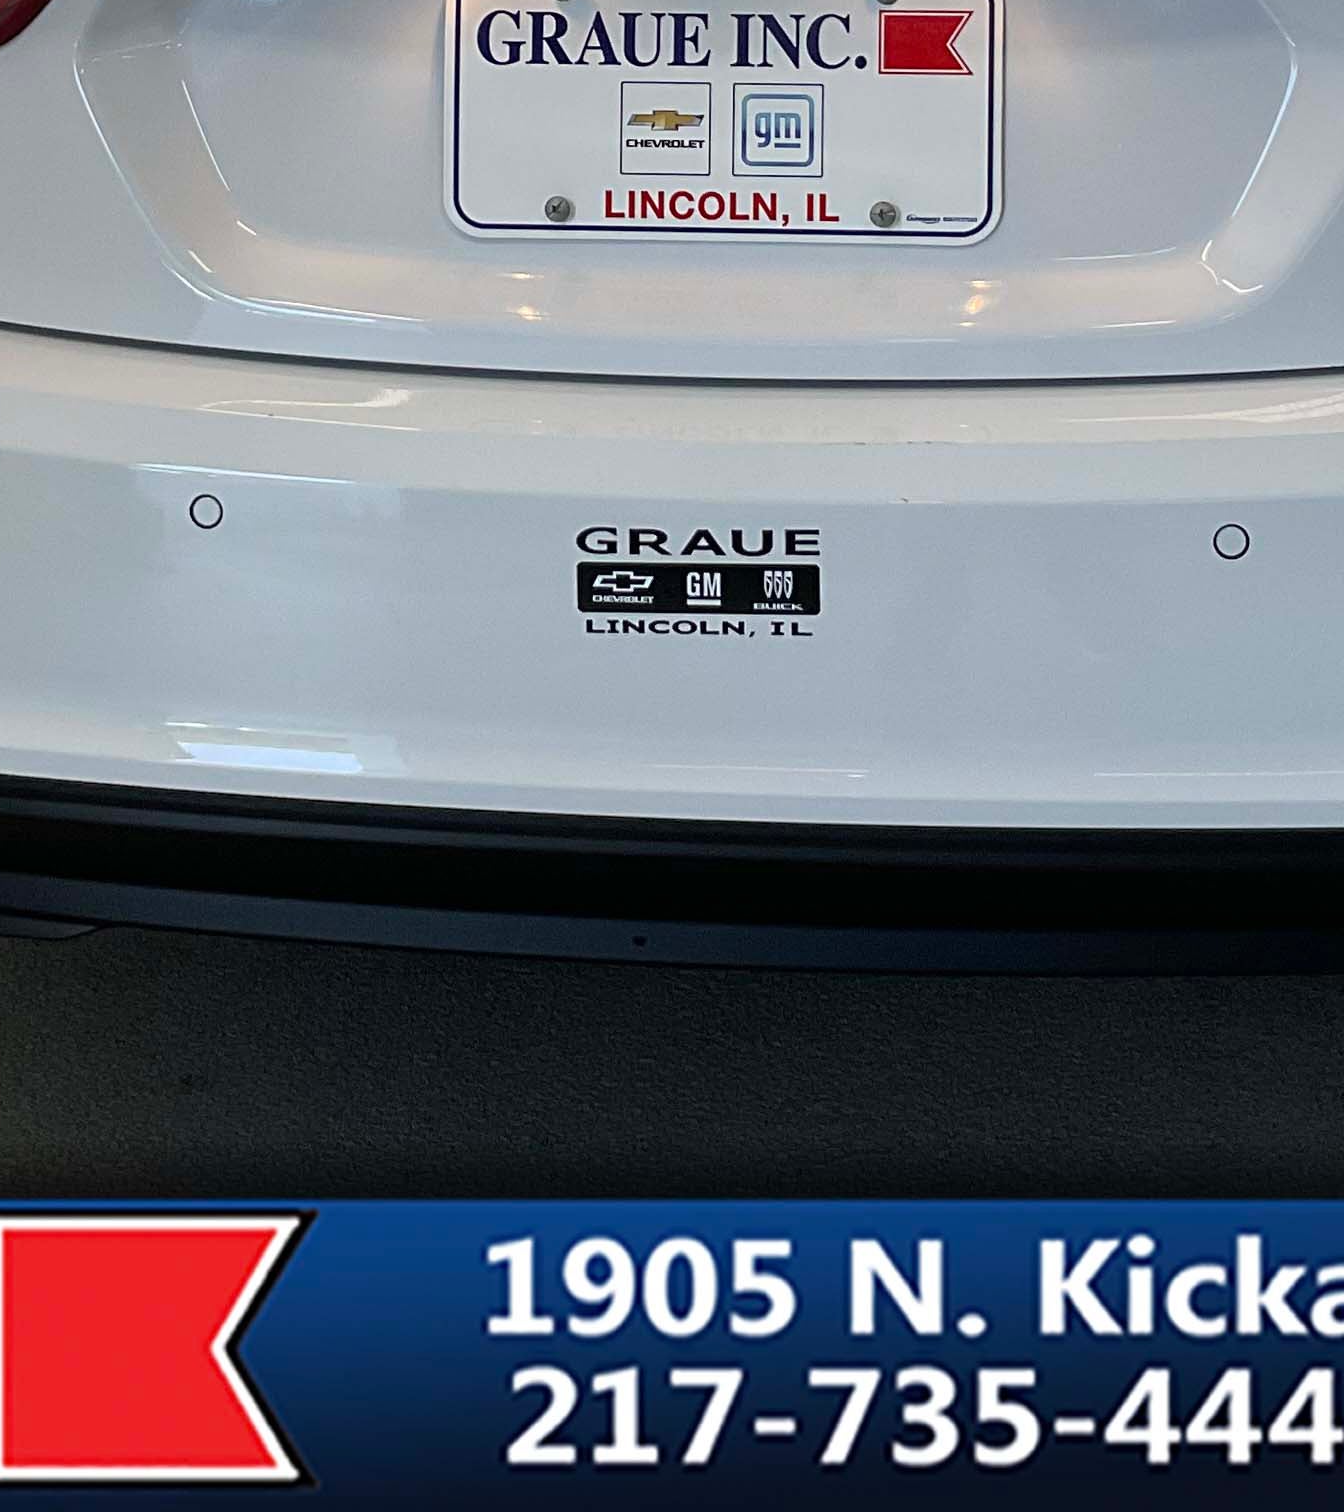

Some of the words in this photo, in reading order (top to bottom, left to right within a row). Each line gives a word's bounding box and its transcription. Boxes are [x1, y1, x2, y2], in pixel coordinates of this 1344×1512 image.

[476, 9, 712, 68] GRAUE
[729, 12, 868, 70] INC.
[624, 137, 706, 150] CHEVROLET
[603, 190, 790, 227] LINCOLN,
[806, 193, 840, 223] IL
[575, 526, 821, 557] GRAUE
[686, 571, 722, 598] GM
[591, 595, 655, 604] CHEVROLET
[753, 603, 805, 611] BUICK
[585, 619, 756, 638] LINCOLN,
[770, 621, 814, 637] IL
